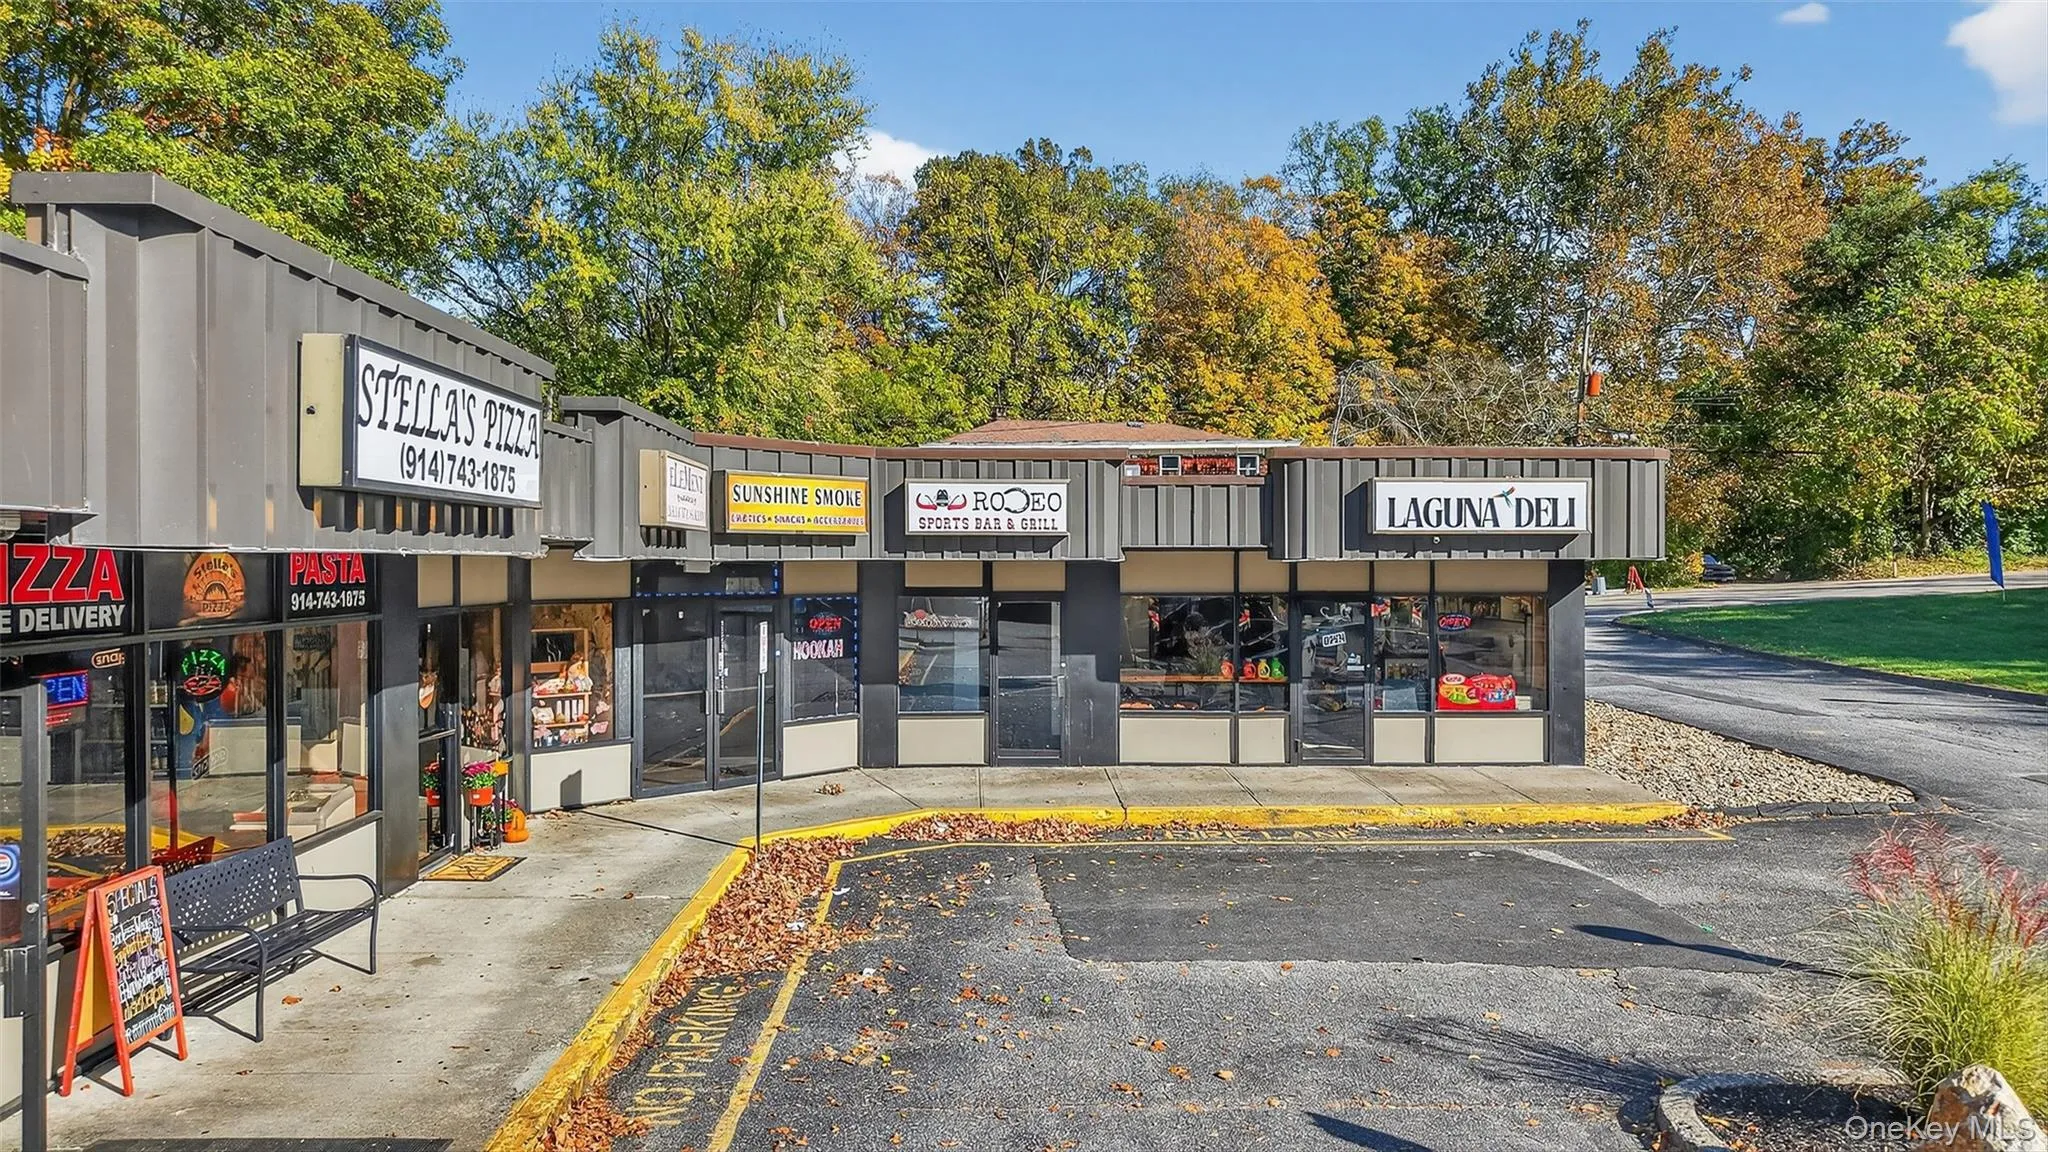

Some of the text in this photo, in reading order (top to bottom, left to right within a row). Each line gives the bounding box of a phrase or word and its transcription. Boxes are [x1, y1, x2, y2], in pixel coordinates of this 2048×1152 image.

[358, 363, 540, 459] STELLA'S PIZZA
[400, 442, 516, 494] (914)743-1875
[732, 483, 862, 508] SUNSHINE SMOKE
[919, 517, 1058, 531] SPORTS BAR & GRILL
[1387, 497, 1576, 528] LAGUNA DELI
[0, 543, 125, 605] IZZA
[290, 551, 366, 586] PASTA
[19, 604, 126, 634] DELIVERY
[1439, 615, 1472, 628] OPEN
[793, 638, 844, 661] HOOKAH
[46, 674, 85, 703] PEN
[106, 875, 159, 917] SPECIALS
[625, 982, 748, 1126] NO PARKING
